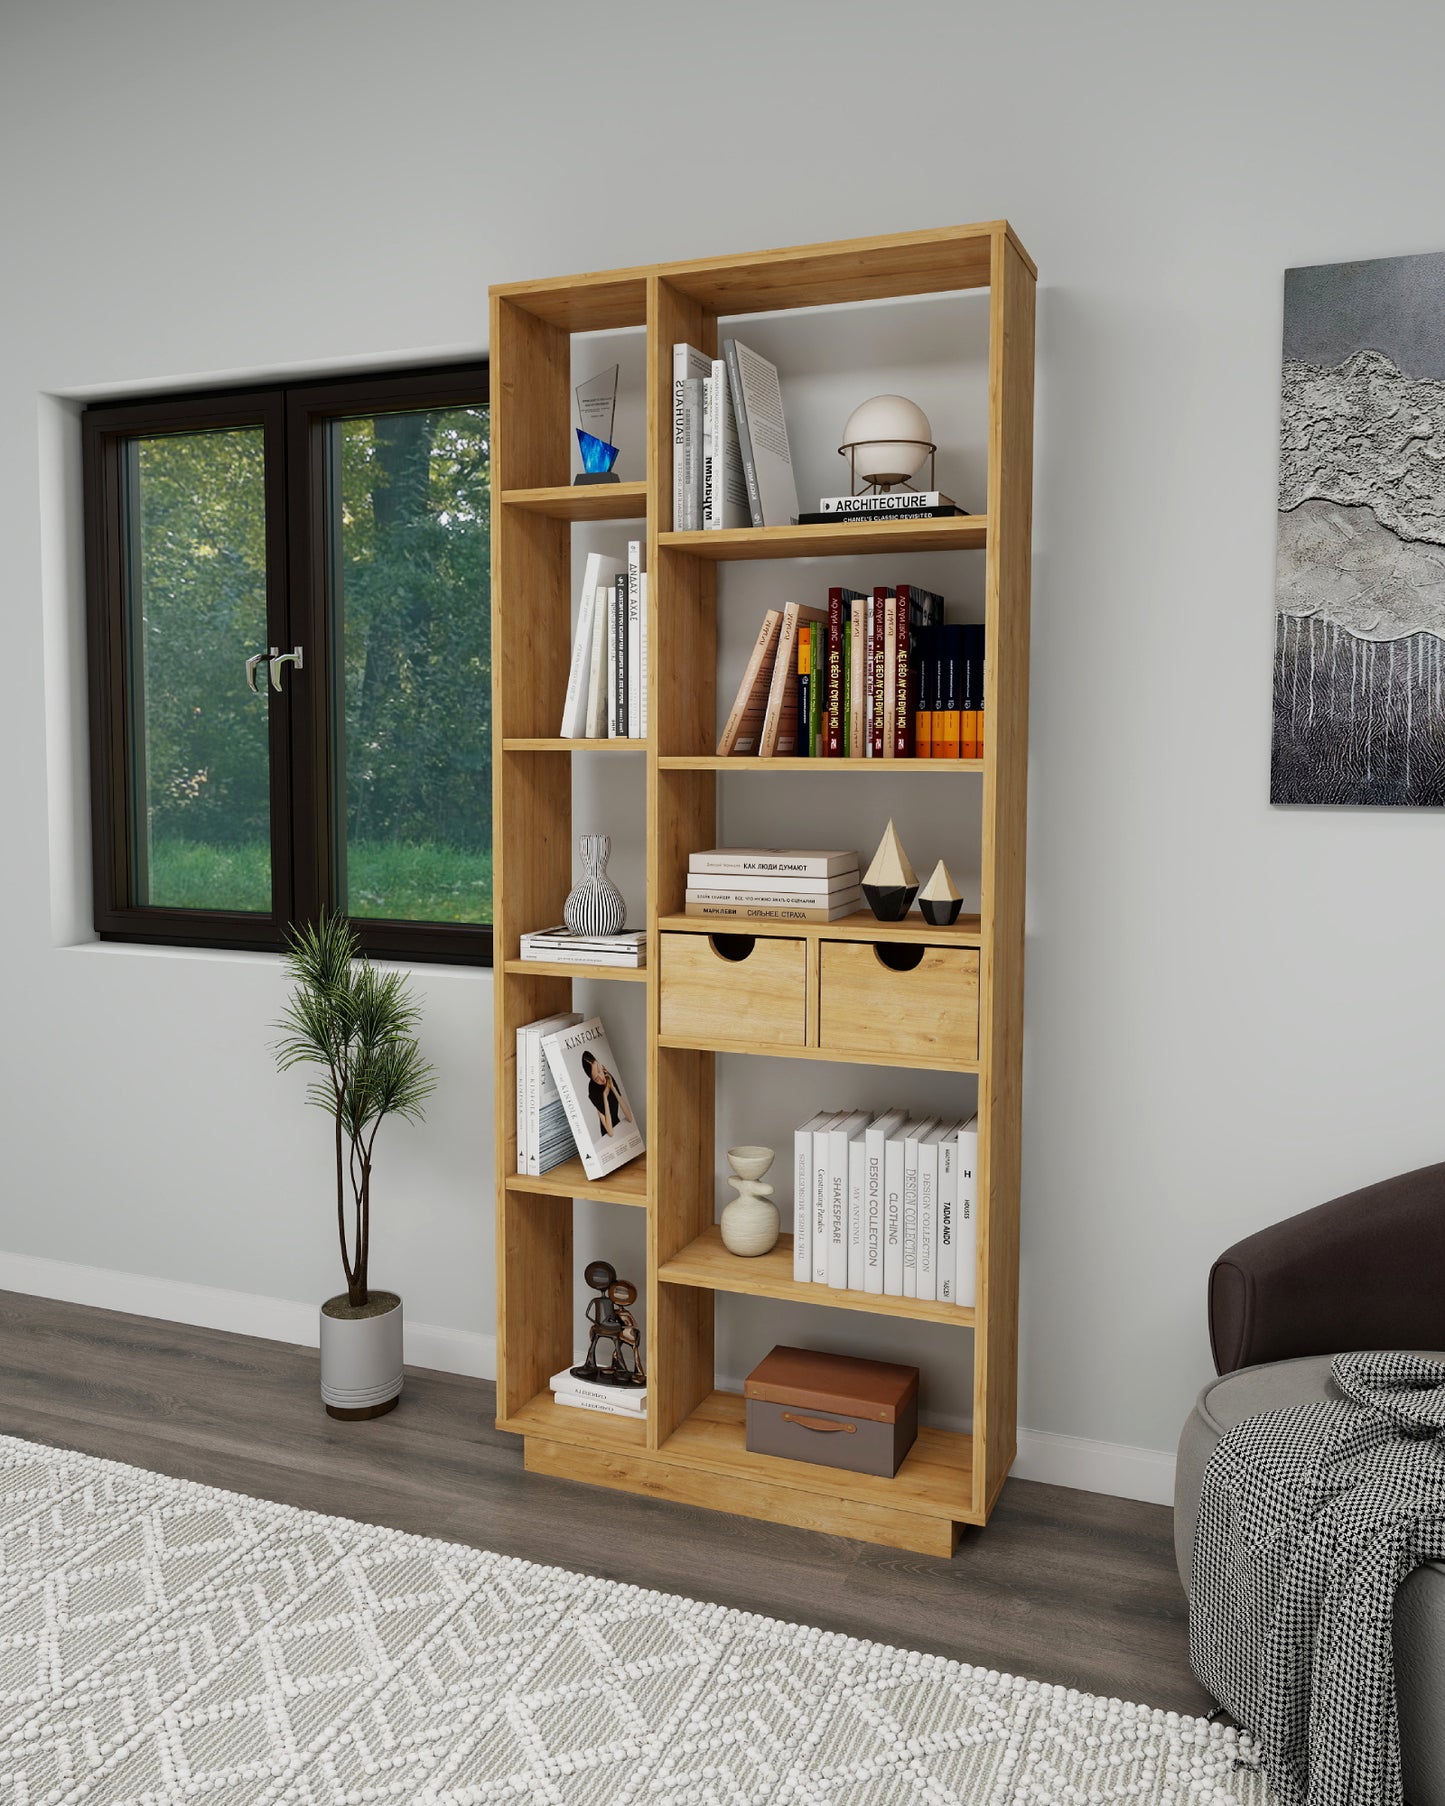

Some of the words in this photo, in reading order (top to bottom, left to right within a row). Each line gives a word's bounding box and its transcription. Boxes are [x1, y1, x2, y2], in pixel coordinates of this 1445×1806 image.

[836, 495, 927, 512] ARCHITECTURE
[843, 515, 872, 523] CHANEL'S
[873, 513, 898, 521] CLASSIC
[900, 512, 933, 520] REVISITED
[743, 862, 756, 870] КАК
[757, 863, 778, 871] ЛЮДИ
[778, 864, 808, 872] ДУМАЮТ
[747, 909, 779, 918] СИЛЬНЕЕ
[781, 911, 807, 919] СТРАХА
[564, 1026, 603, 1051] KINFOLK
[869, 1157, 878, 1198] DESIGN
[905, 1169, 917, 1204] DESIGN
[922, 1173, 931, 1211] DESIGN
[833, 1177, 842, 1244] SHAKESPEARE
[889, 1192, 898, 1246] CLOTHING
[943, 1202, 951, 1224] TADAO
[869, 1199, 878, 1267] COLLECTION
[904, 1205, 916, 1269] COLLECTION
[922, 1214, 931, 1273] COLLECTION
[943, 1225, 951, 1246] ANDO
